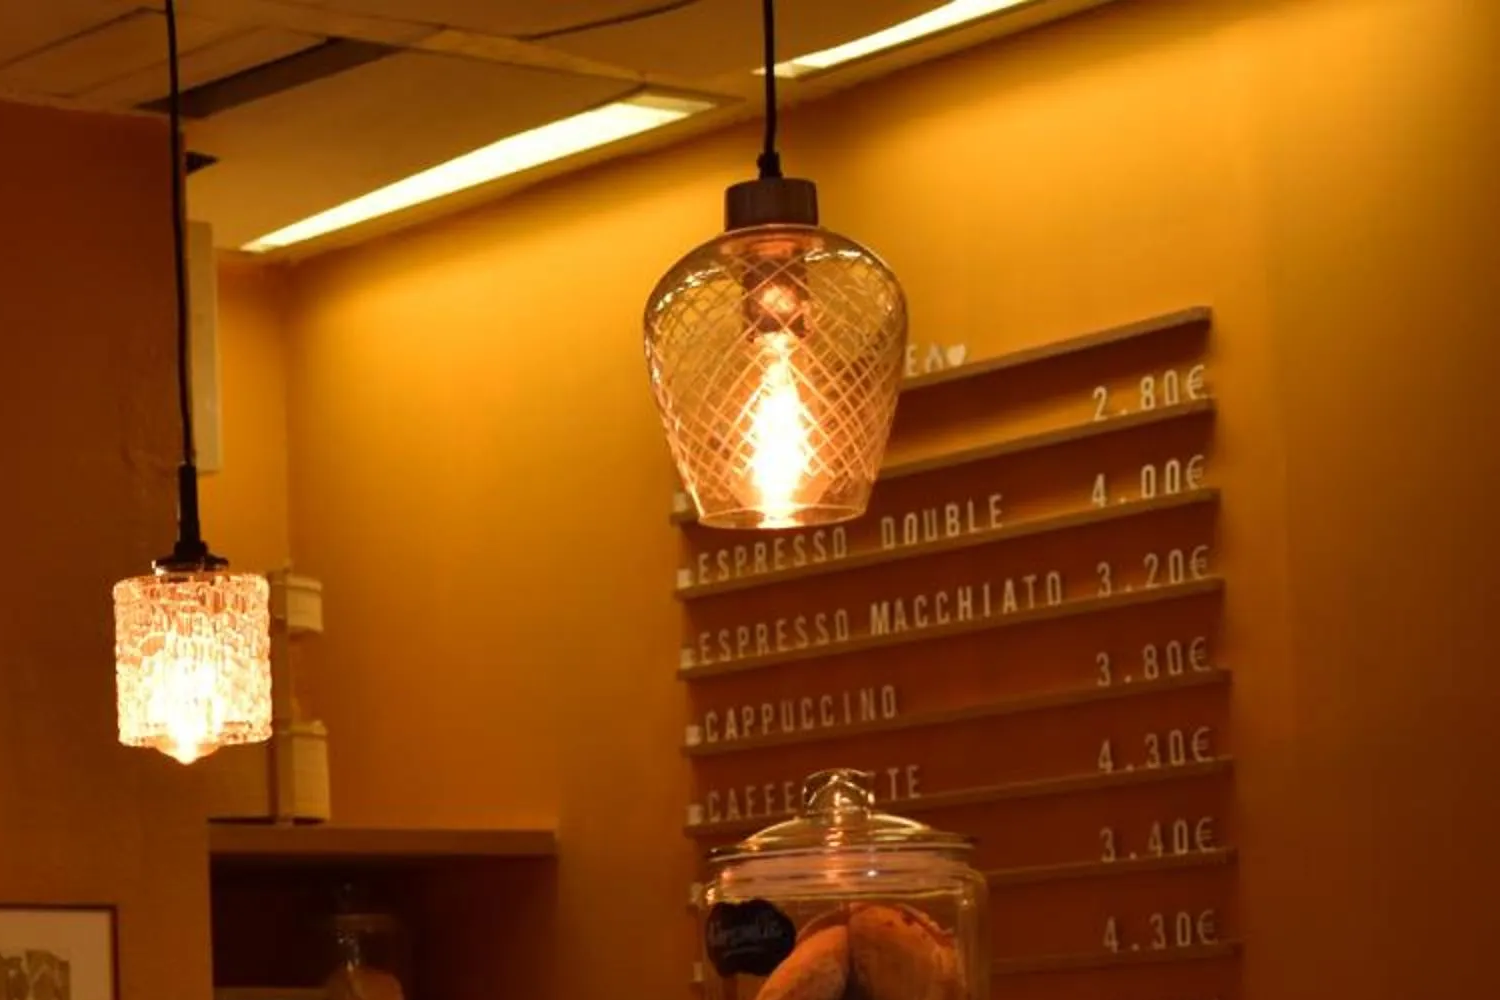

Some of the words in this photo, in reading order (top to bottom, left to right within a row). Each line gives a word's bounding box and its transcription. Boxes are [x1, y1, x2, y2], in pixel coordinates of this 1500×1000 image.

[1092, 364, 1207, 422] 2.80€
[698, 526, 848, 585] ESPRESSO
[880, 493, 1003, 550] DOUBLE
[1092, 454, 1205, 509] 4.00€
[698, 608, 850, 665] ESPRESSO
[869, 570, 1063, 636] MACCHIATO
[1096, 545, 1210, 598] 3.20€
[704, 684, 897, 743] CAPPUCCINO
[1096, 636, 1212, 687] 3.80€
[1098, 726, 1214, 775] 4.30€
[1100, 816, 1216, 863] 3.40€
[1103, 908, 1219, 953] 4.30€
